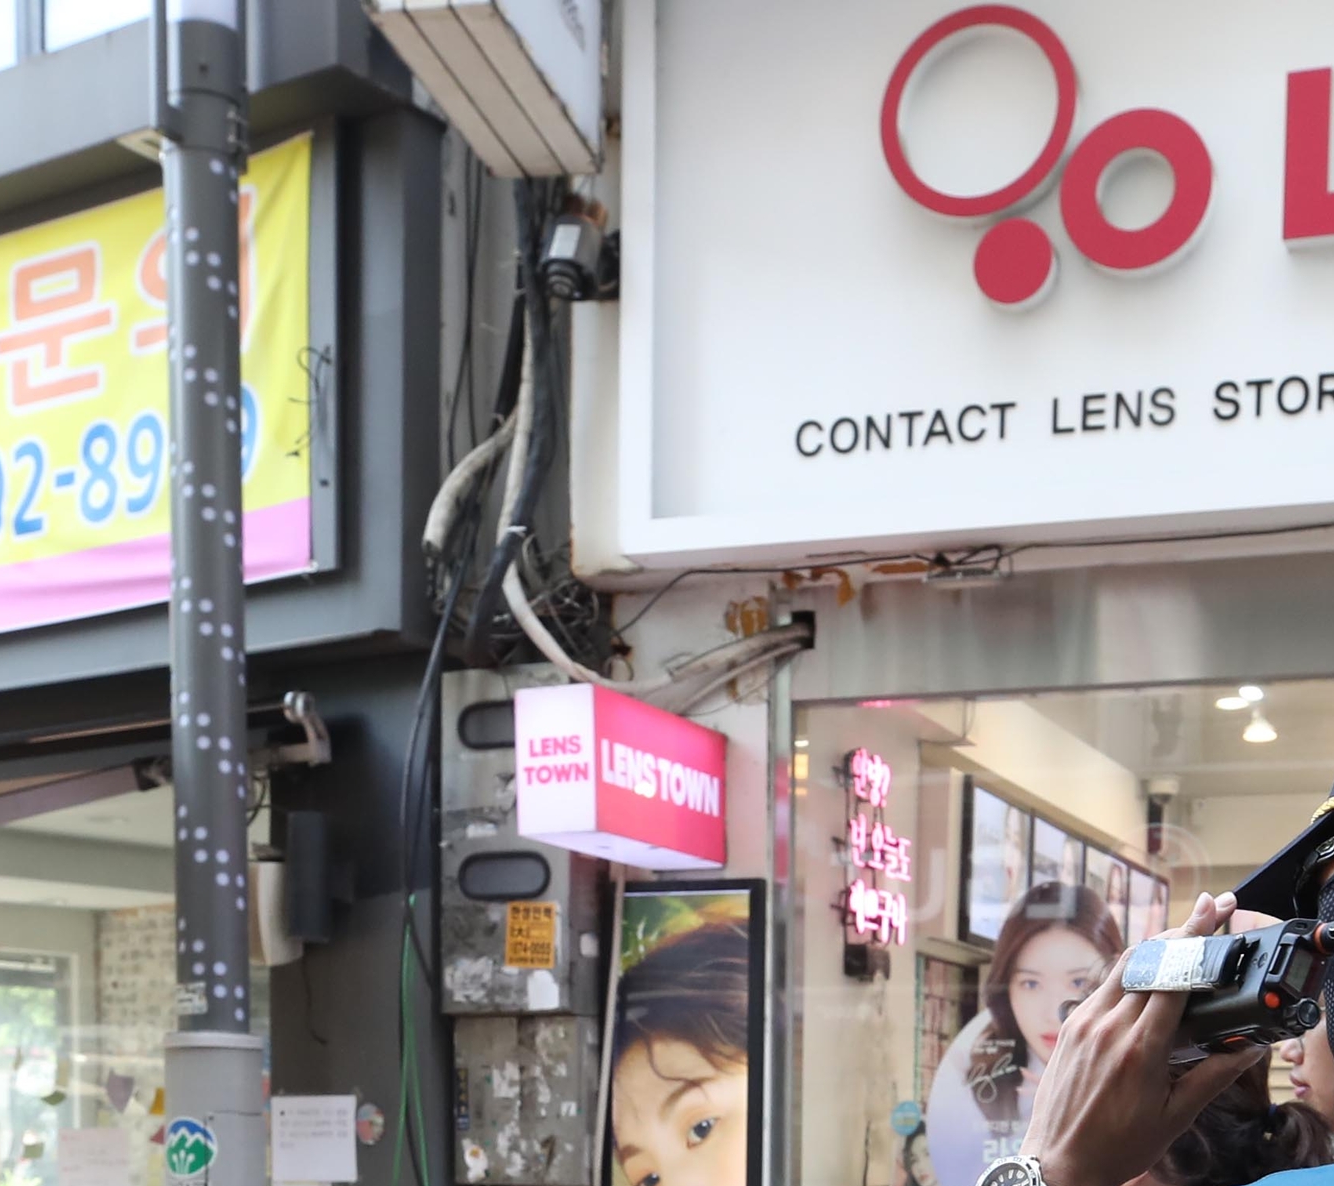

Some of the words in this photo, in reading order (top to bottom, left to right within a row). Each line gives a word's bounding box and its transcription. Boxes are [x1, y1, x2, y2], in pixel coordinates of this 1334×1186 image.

[794, 402, 1017, 458] CONTACT
[1051, 386, 1176, 436] LENS
[524, 762, 589, 786] TOWN
[529, 735, 582, 758] LENS
[601, 738, 658, 798] LENS
[657, 757, 720, 817] TOWN
[869, 822, 912, 881] 오늘도
